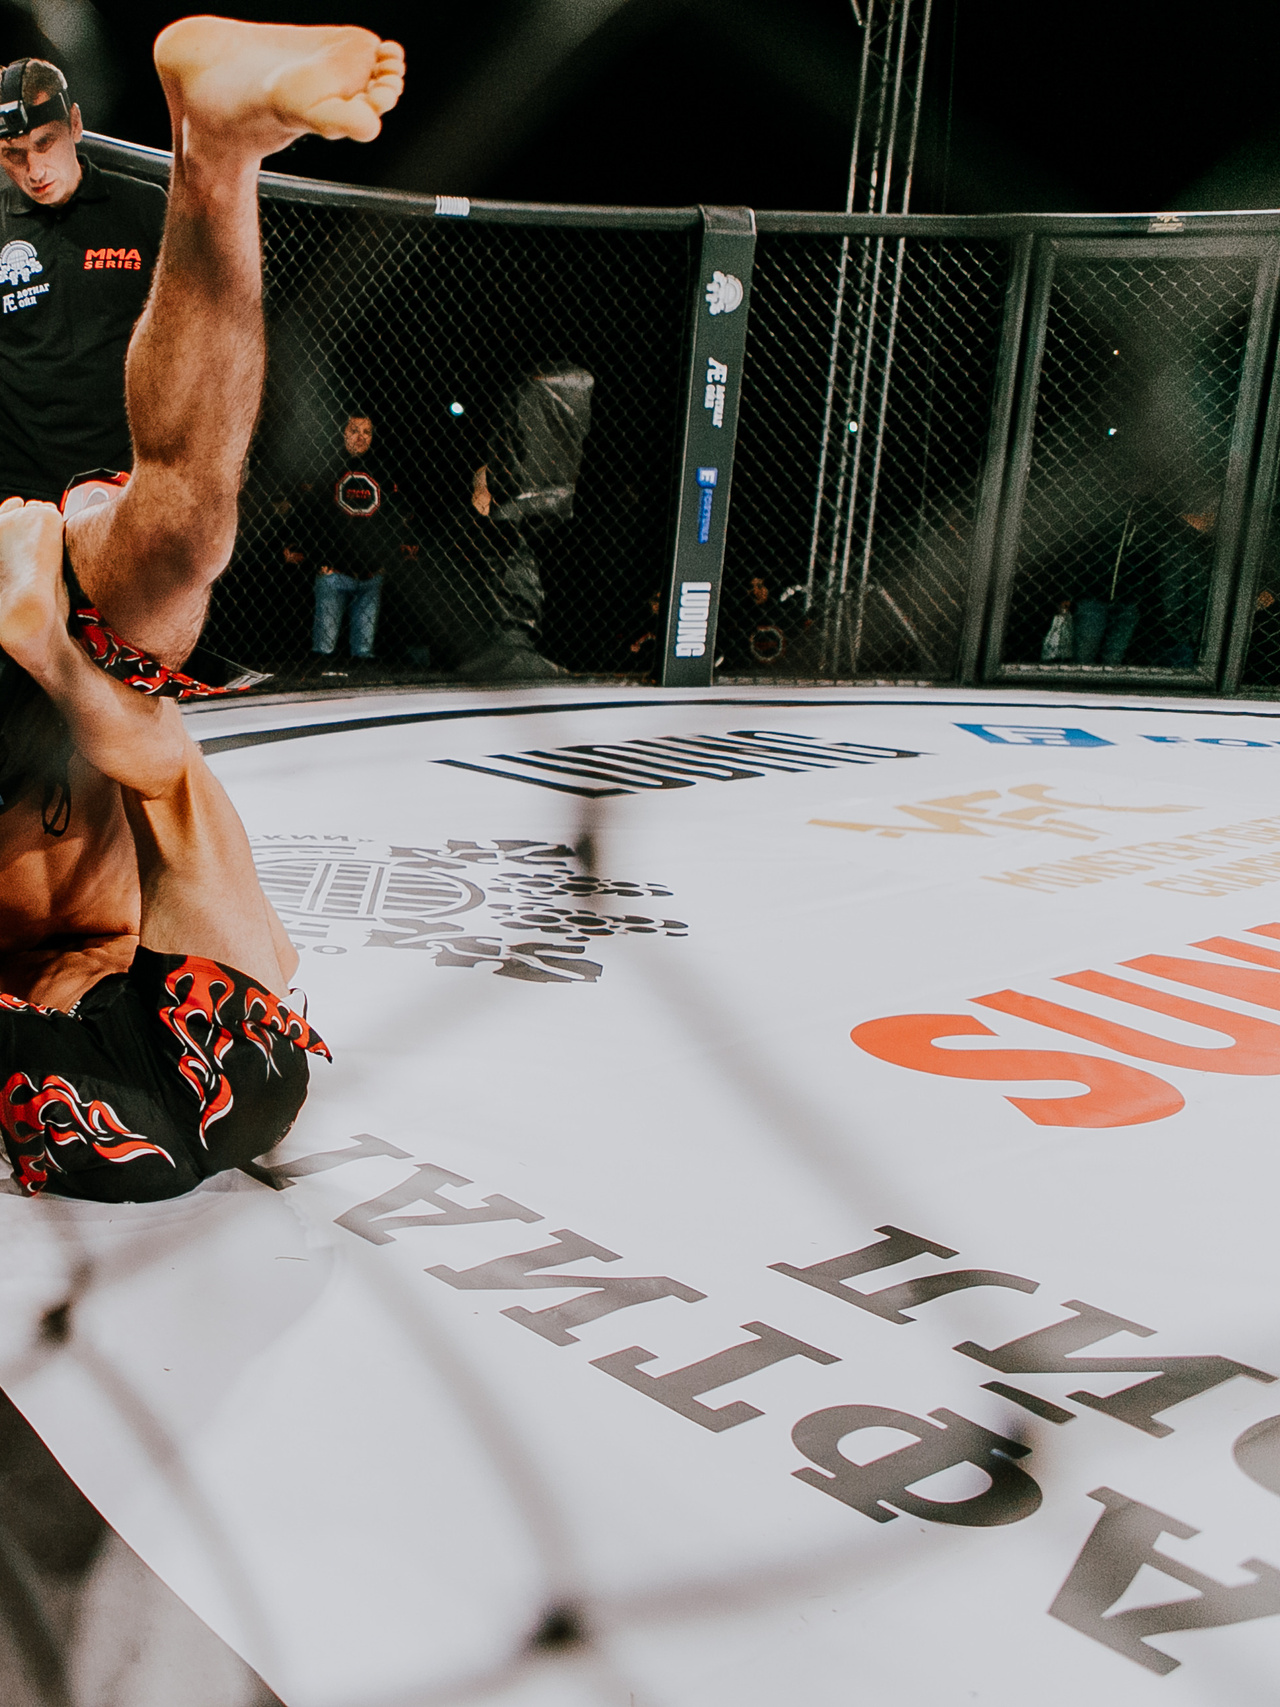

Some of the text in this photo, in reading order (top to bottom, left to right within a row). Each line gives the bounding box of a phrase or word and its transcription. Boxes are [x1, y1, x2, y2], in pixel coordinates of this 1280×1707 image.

[83, 260, 142, 270] SERIES
[85, 248, 142, 261] MMA
[676, 582, 711, 657] LUDING
[429, 729, 932, 799] LUDING
[980, 841, 1228, 894] MONSTER
